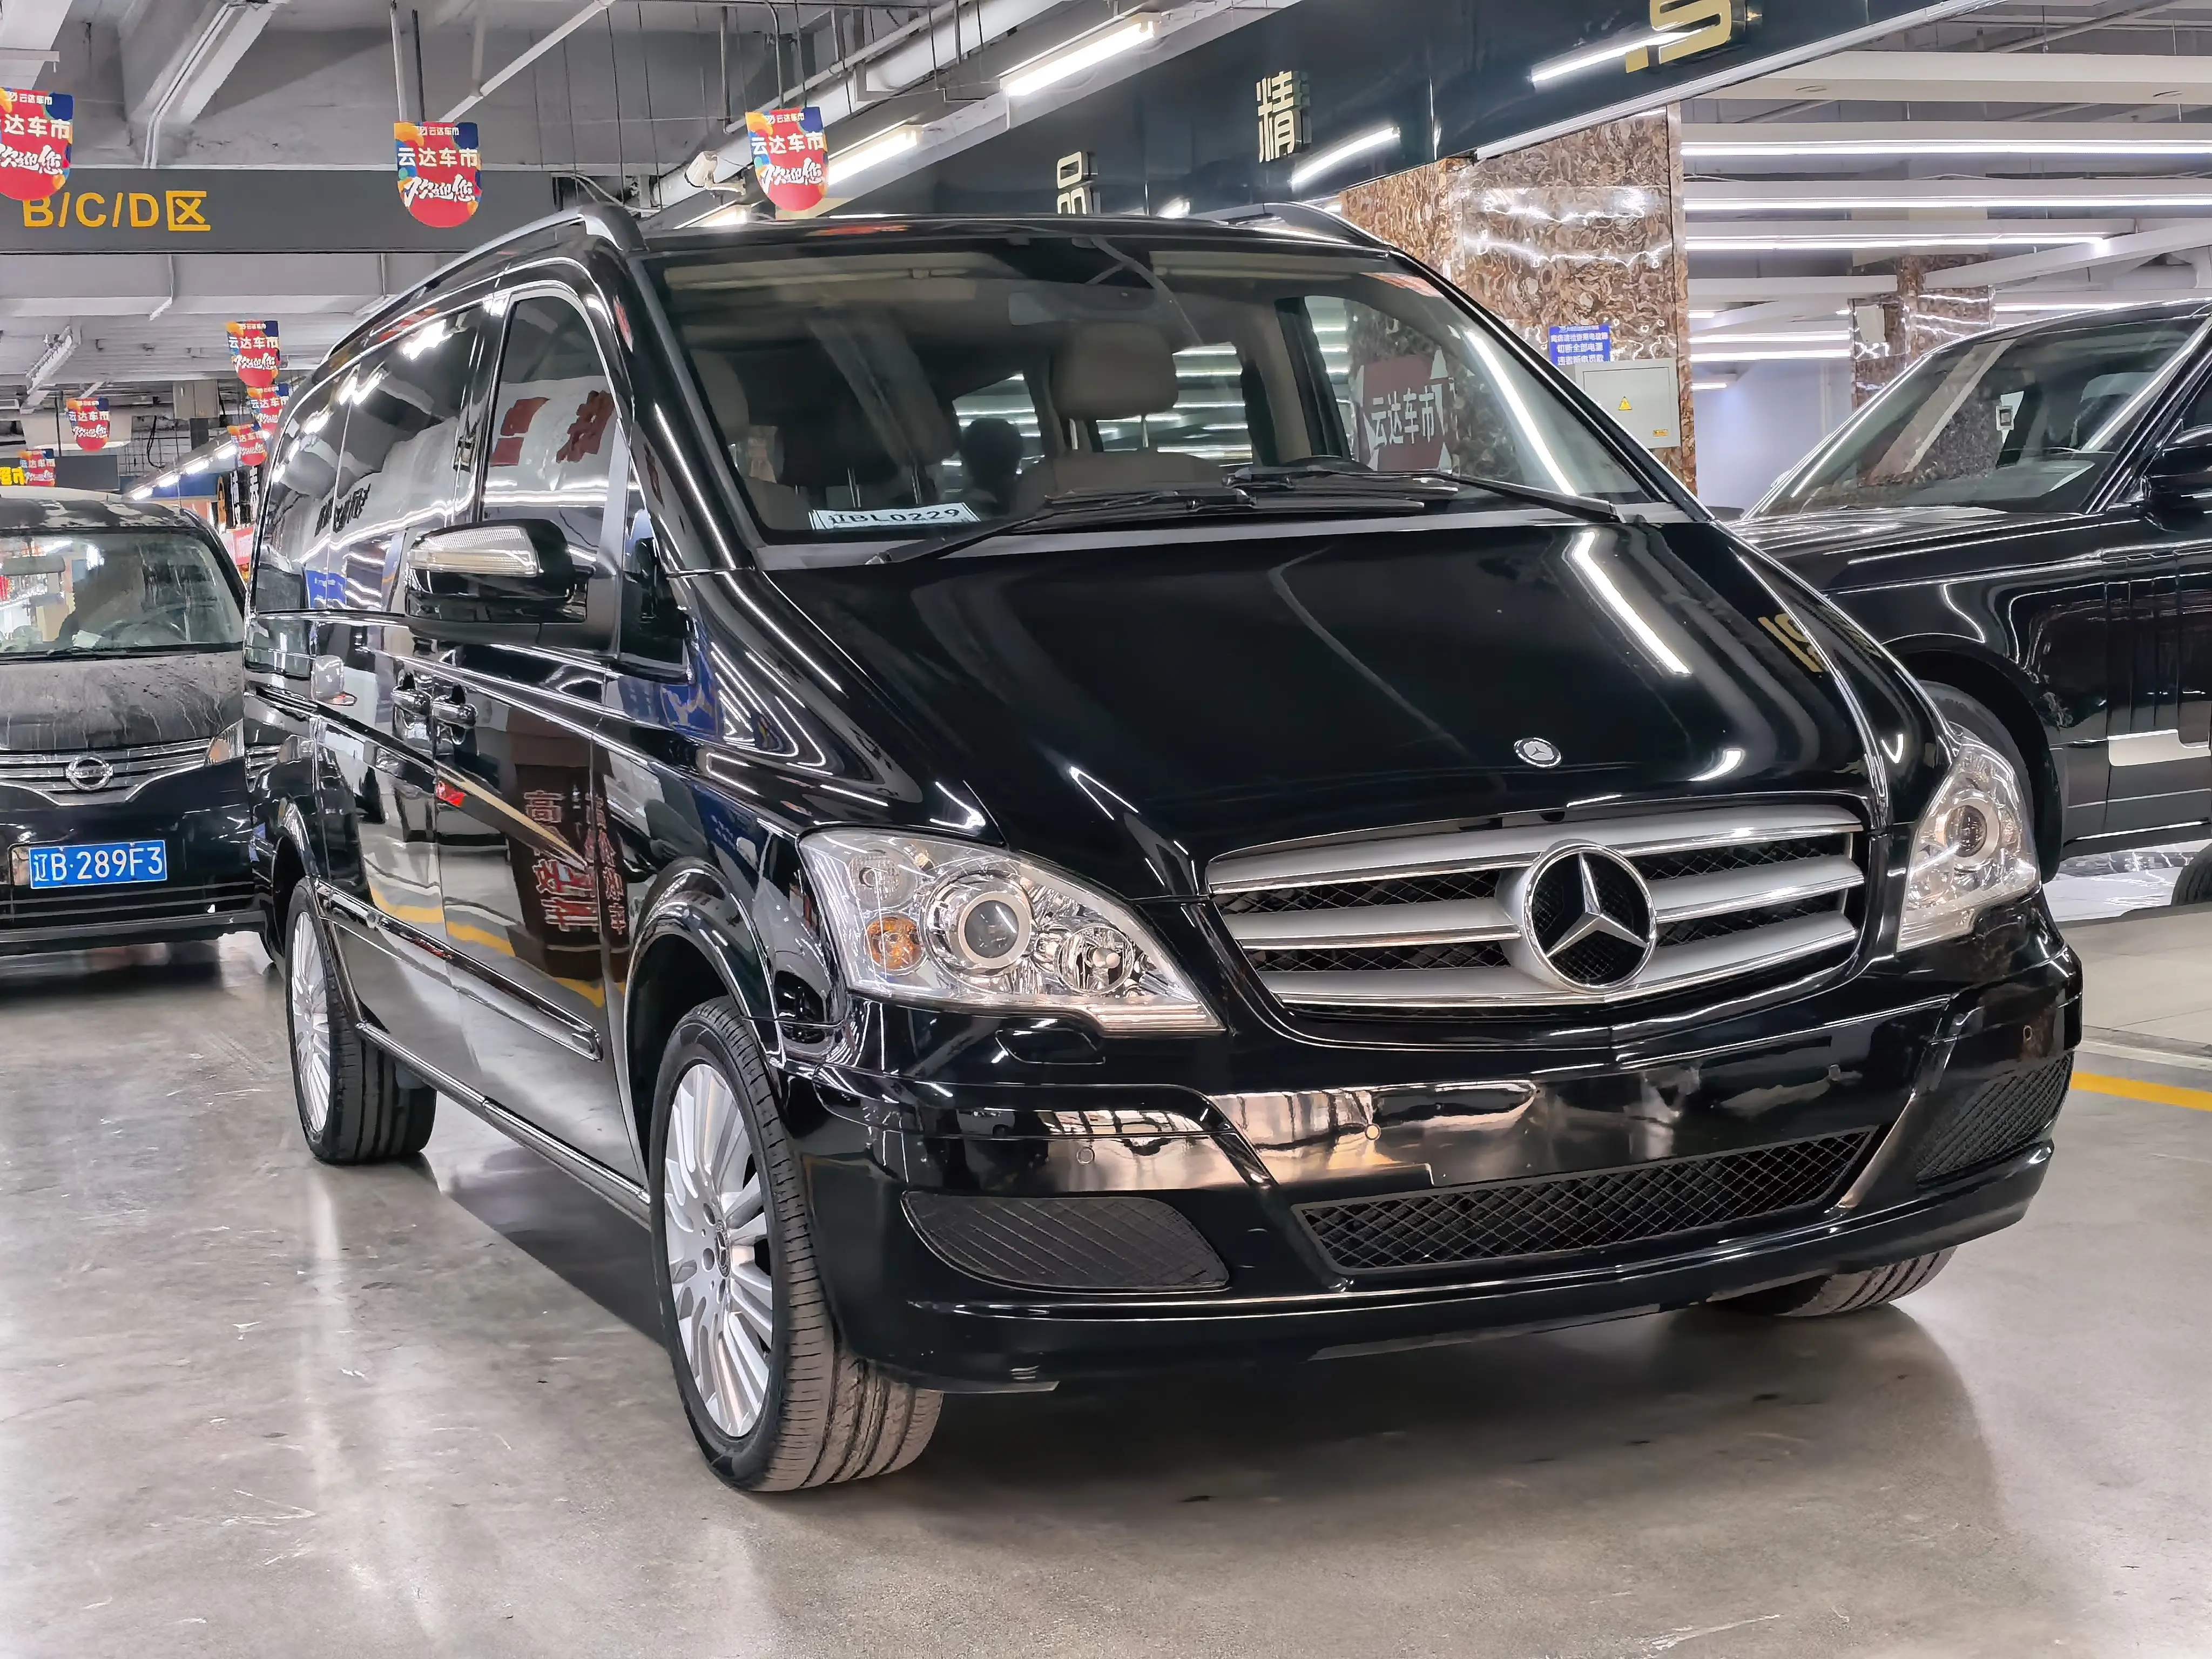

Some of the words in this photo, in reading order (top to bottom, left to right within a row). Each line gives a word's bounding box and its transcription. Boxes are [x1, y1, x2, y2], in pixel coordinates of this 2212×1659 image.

[0, 114, 71, 140] 达车市
[1256, 71, 1296, 163] 精
[397, 147, 478, 167] 云达车市
[751, 131, 824, 154] 云达车市
[403, 174, 475, 207] 欢迎您
[760, 157, 825, 194] 欢迎您
[1057, 151, 1087, 214] 品
[228, 336, 279, 349] 云达车市
[1371, 385, 1435, 446] 云达车市
